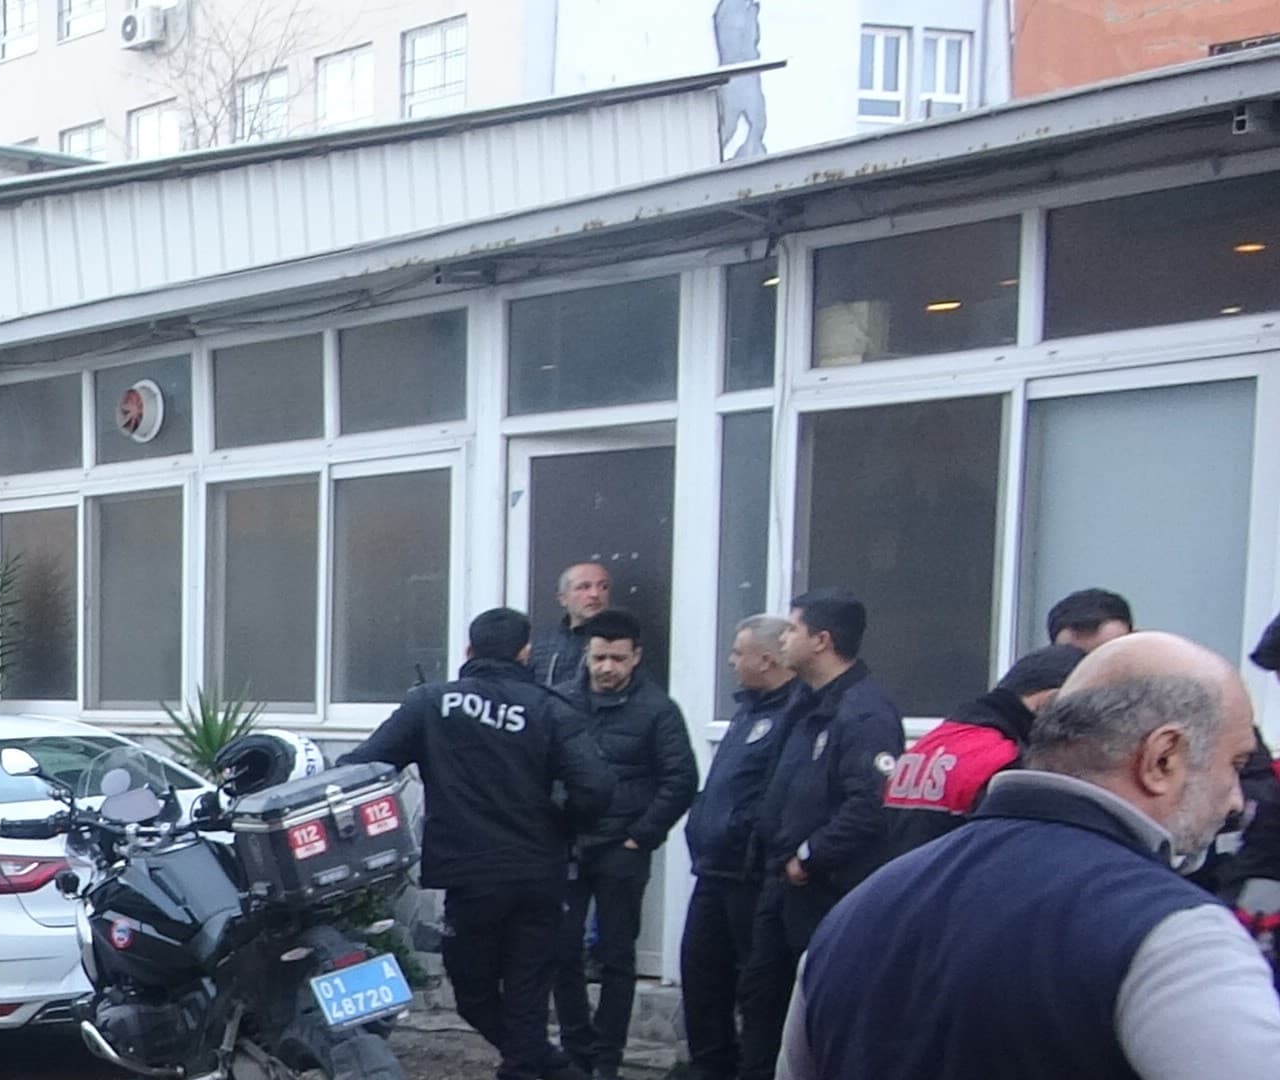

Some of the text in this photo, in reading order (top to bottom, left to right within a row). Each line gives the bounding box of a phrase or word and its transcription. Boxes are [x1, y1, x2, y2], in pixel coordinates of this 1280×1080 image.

[365, 801, 392, 822] 112
[293, 825, 320, 846] 112
[320, 961, 397, 999] 01 A
[331, 985, 394, 1019] 48720
